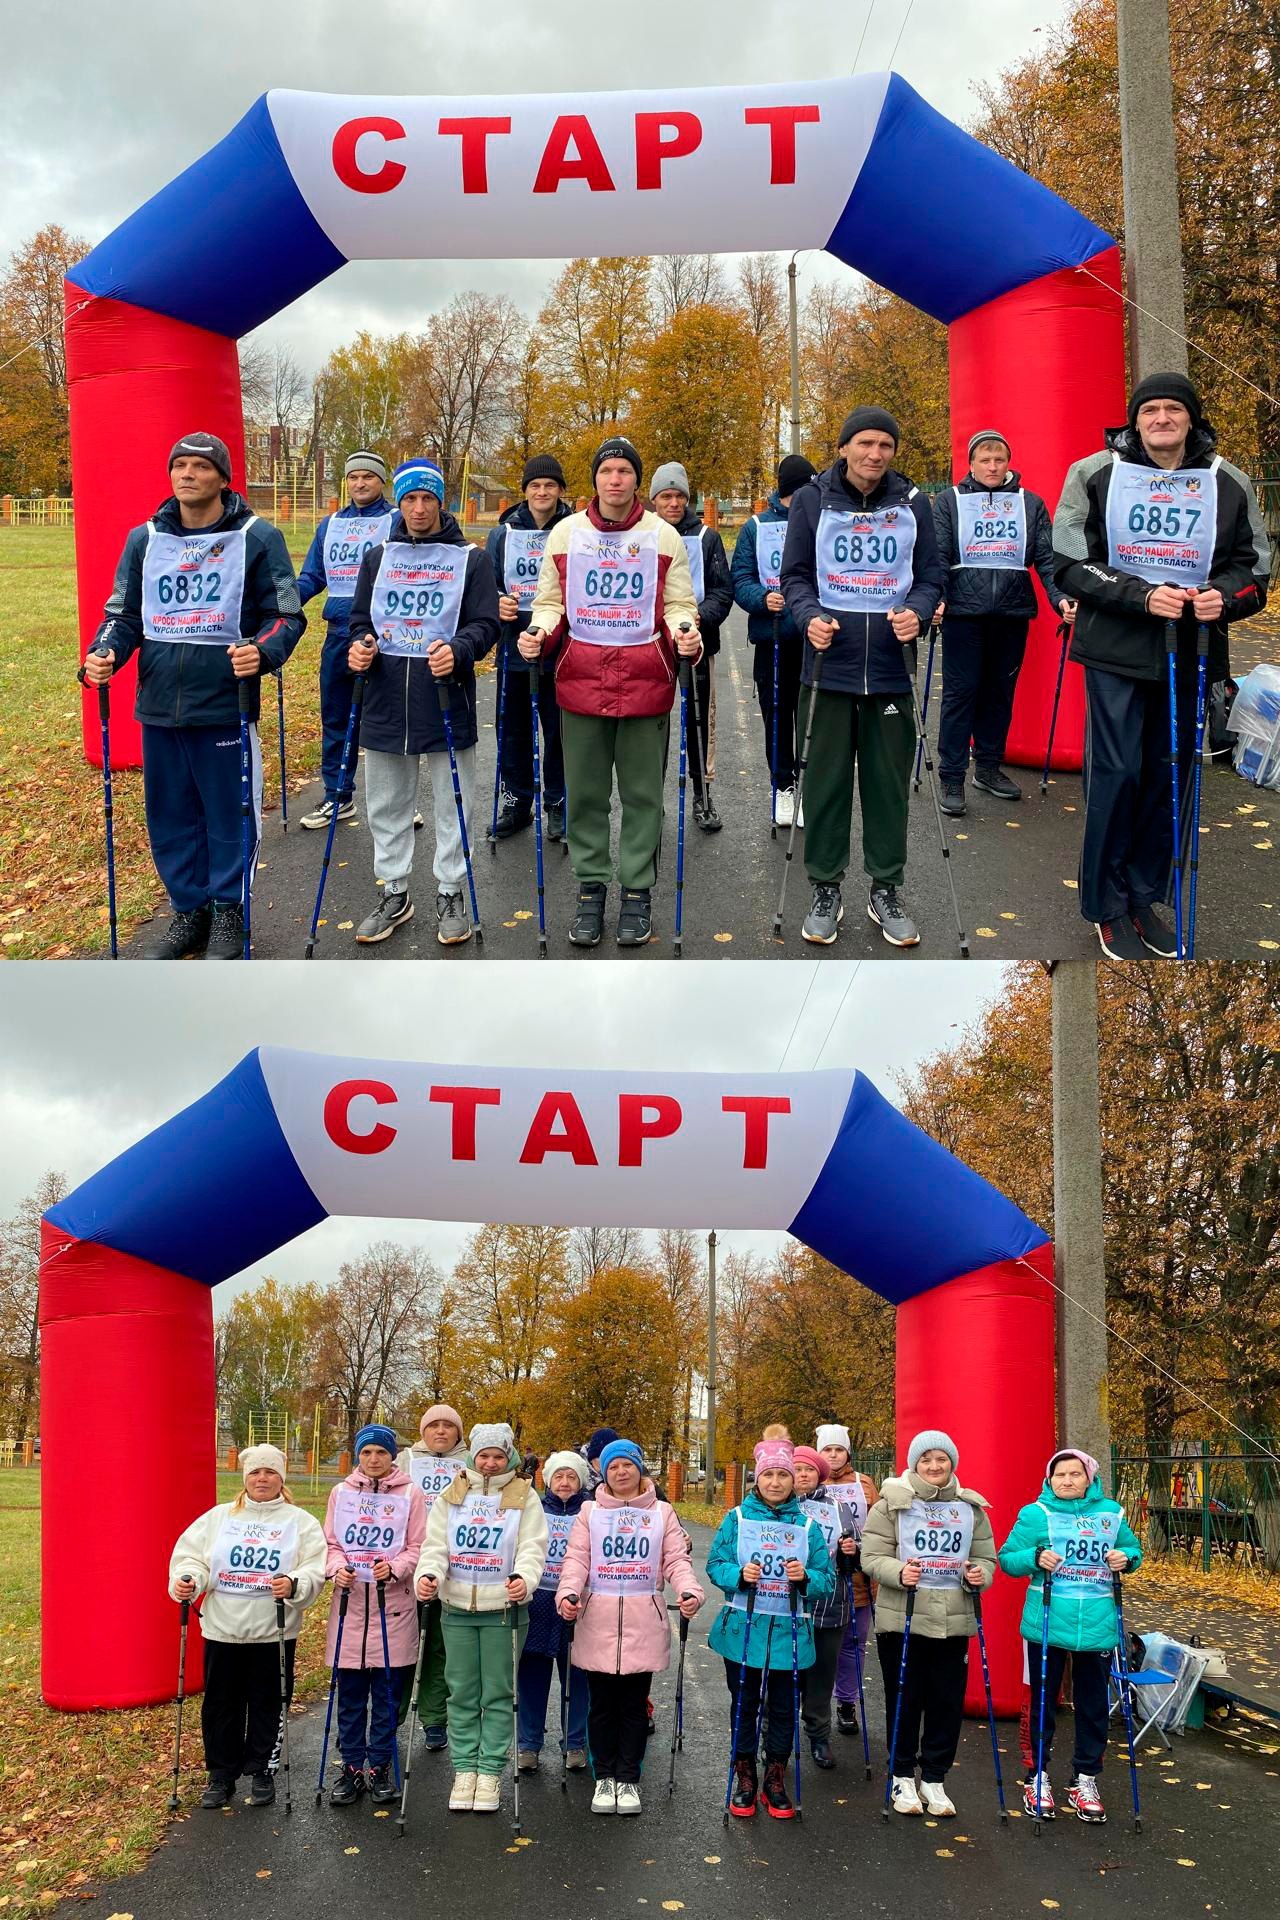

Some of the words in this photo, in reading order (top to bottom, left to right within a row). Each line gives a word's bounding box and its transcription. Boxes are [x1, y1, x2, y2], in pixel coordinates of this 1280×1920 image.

[332, 105, 820, 194] СТАРТ
[974, 520, 1018, 539] 6825
[1128, 503, 1202, 539] 6857
[834, 535, 897, 564] 6830
[1117, 544, 1143, 555] КРОСС
[1145, 546, 1175, 558] НАЦИИ
[1181, 549, 1199, 559] 2013
[516, 556, 543, 577] 68
[770, 550, 781, 570] 6
[1119, 553, 1156, 565] КУРСКАЯ
[1159, 558, 1197, 569] ОБЛАСТЬ
[158, 572, 221, 604] 6832
[585, 569, 644, 599] 6829
[827, 574, 849, 584] КРОСС
[851, 576, 877, 586] НАЦИИ
[883, 578, 898, 587] 2013
[828, 584, 860, 593] КУРСКАЯ
[862, 587, 897, 595] ОБЛАСТЬ
[384, 591, 444, 617] 6856
[576, 608, 596, 617] КРОСС
[598, 608, 621, 618] НАЦИИ
[627, 609, 642, 619] 2013
[152, 615, 176, 625] КРОСС
[177, 614, 201, 624] НАЦИИ
[207, 613, 226, 623] 2013
[577, 617, 606, 627] КУРСКАЯ
[607, 619, 640, 628] ОБЛАСТЬ
[153, 625, 184, 634] КУРСКАЯ
[185, 624, 222, 633] ОБЛАСТЬ
[324, 1079, 792, 1169] СТАРТ
[422, 1475, 452, 1491] 682
[344, 1523, 395, 1548] 6829
[455, 1524, 504, 1550] 6827
[914, 1529, 962, 1553] 6828
[602, 1535, 650, 1559] 6840
[230, 1545, 281, 1572] 6825
[466, 1556, 486, 1565] НАЦИИ
[490, 1557, 503, 1565] 2013
[926, 1560, 948, 1568] НАЦИИ
[598, 1565, 615, 1573] КРОСС
[237, 1575, 259, 1583] НАЦИИ
